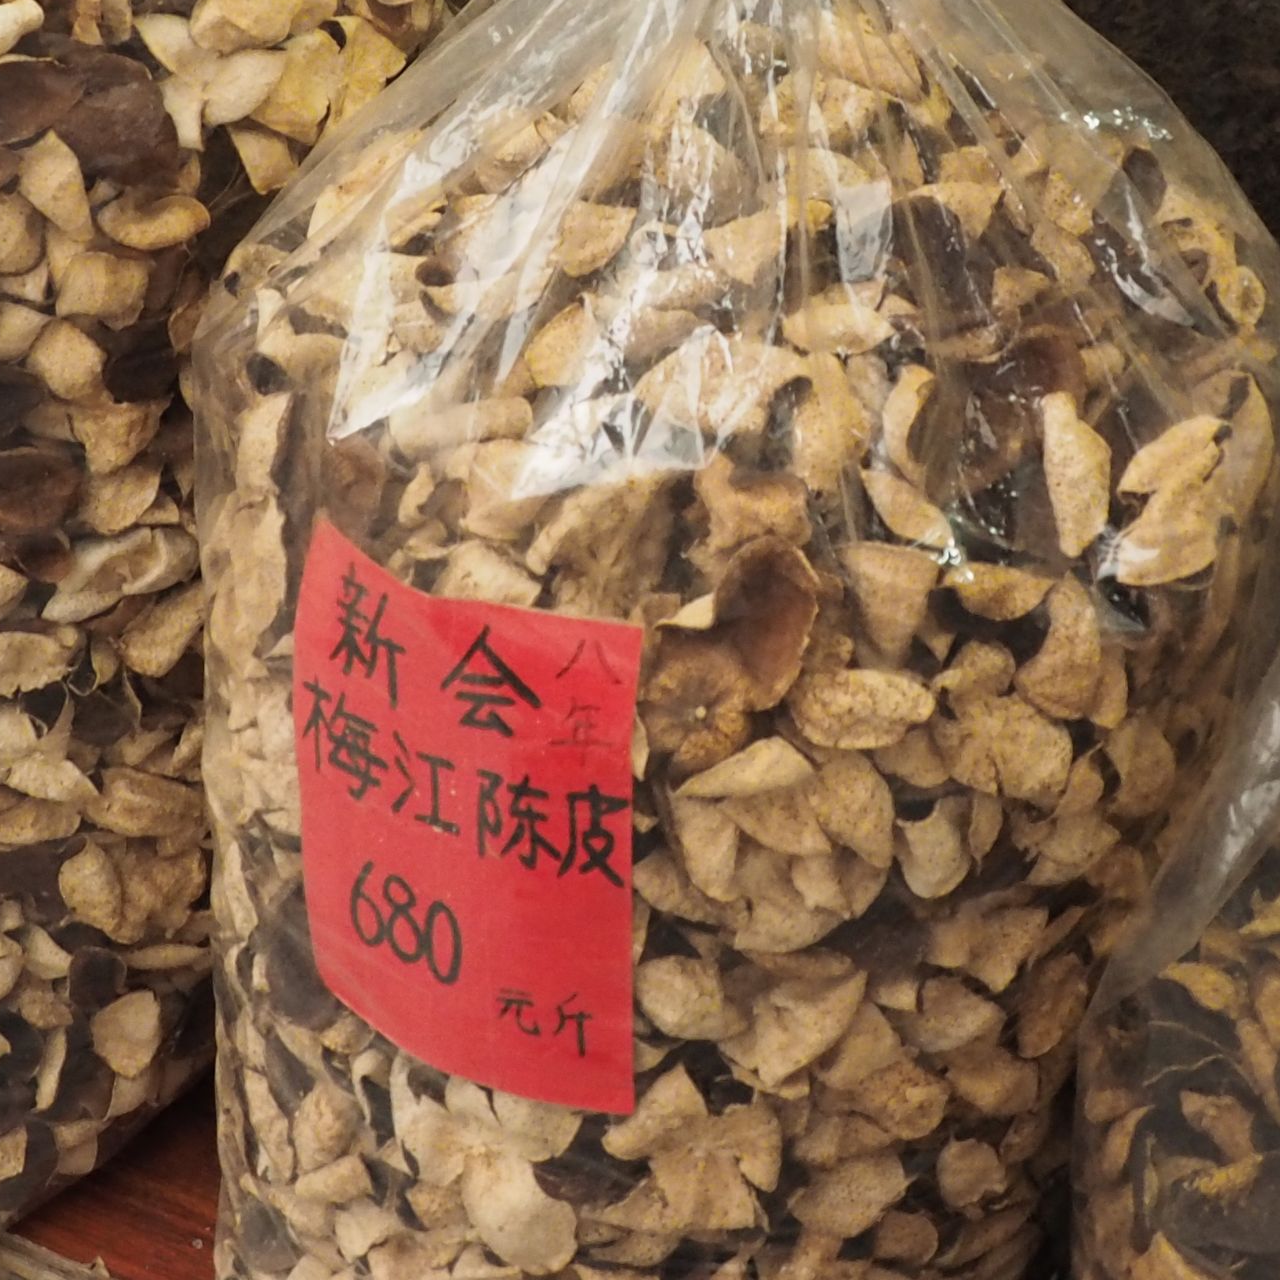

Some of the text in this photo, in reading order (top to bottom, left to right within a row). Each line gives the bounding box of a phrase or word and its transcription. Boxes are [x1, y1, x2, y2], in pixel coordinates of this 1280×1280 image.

[329, 562, 542, 738] 新会
[549, 638, 622, 768] 八年
[301, 674, 630, 889] 梅江陈皮
